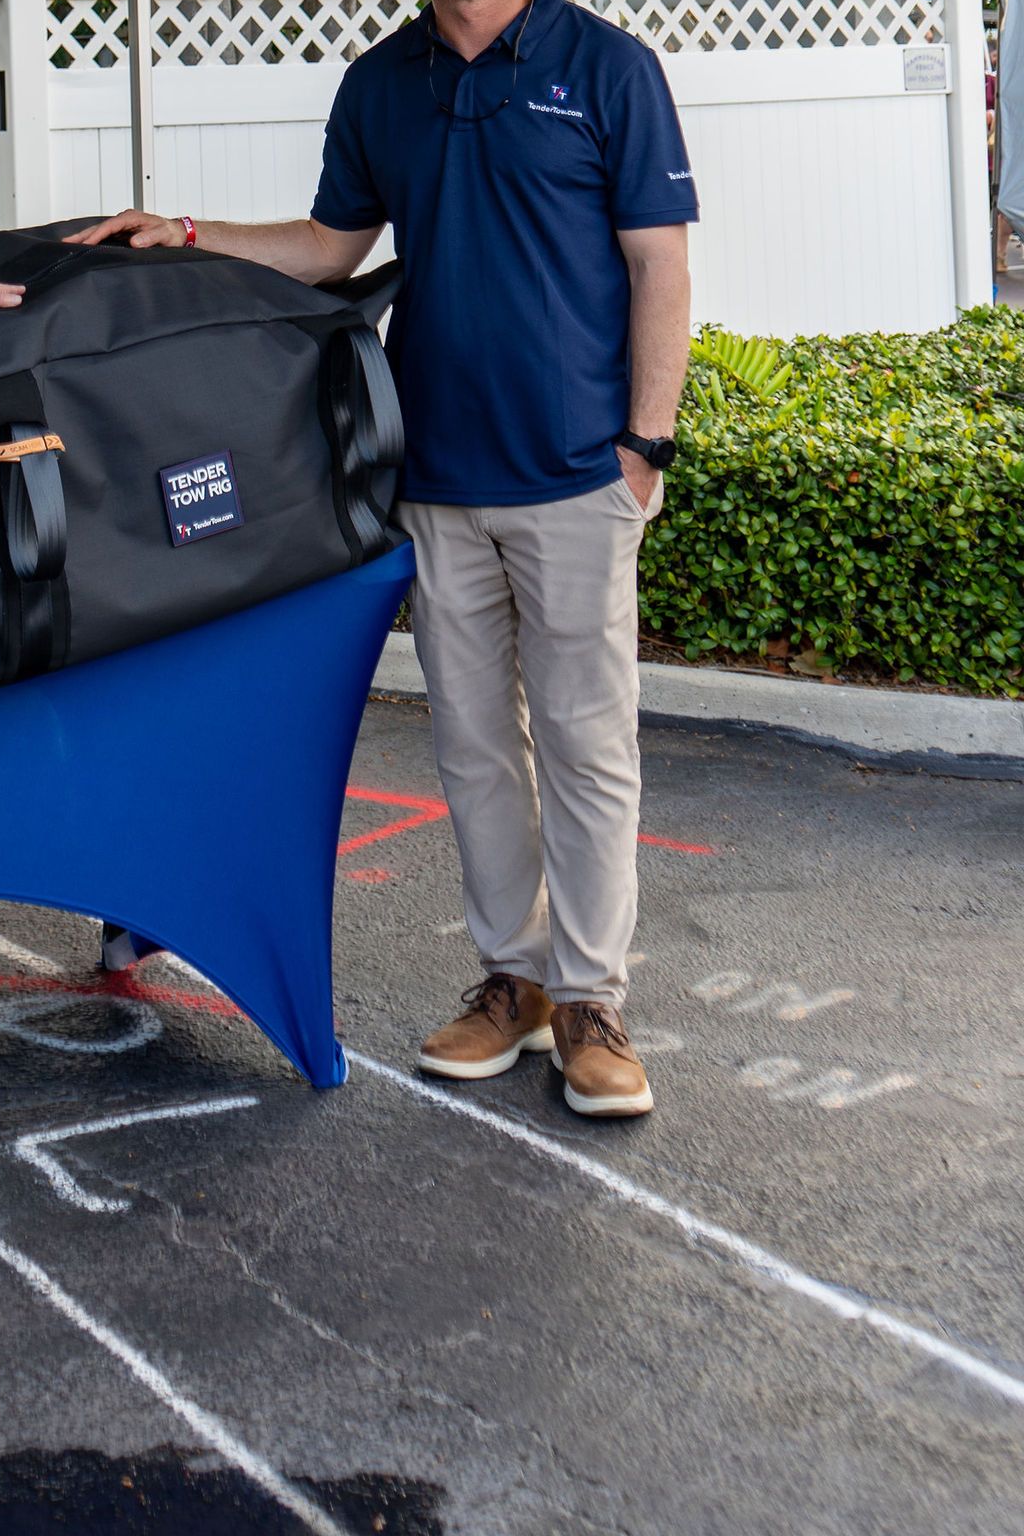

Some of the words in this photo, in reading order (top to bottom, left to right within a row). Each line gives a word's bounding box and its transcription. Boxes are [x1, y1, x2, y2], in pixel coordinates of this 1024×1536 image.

[528, 101, 583, 119] TenderTow.com
[168, 460, 227, 492] TENDER
[170, 485, 205, 509] TOW
[208, 478, 232, 498] RIG
[193, 513, 234, 531] TenderTow.com
